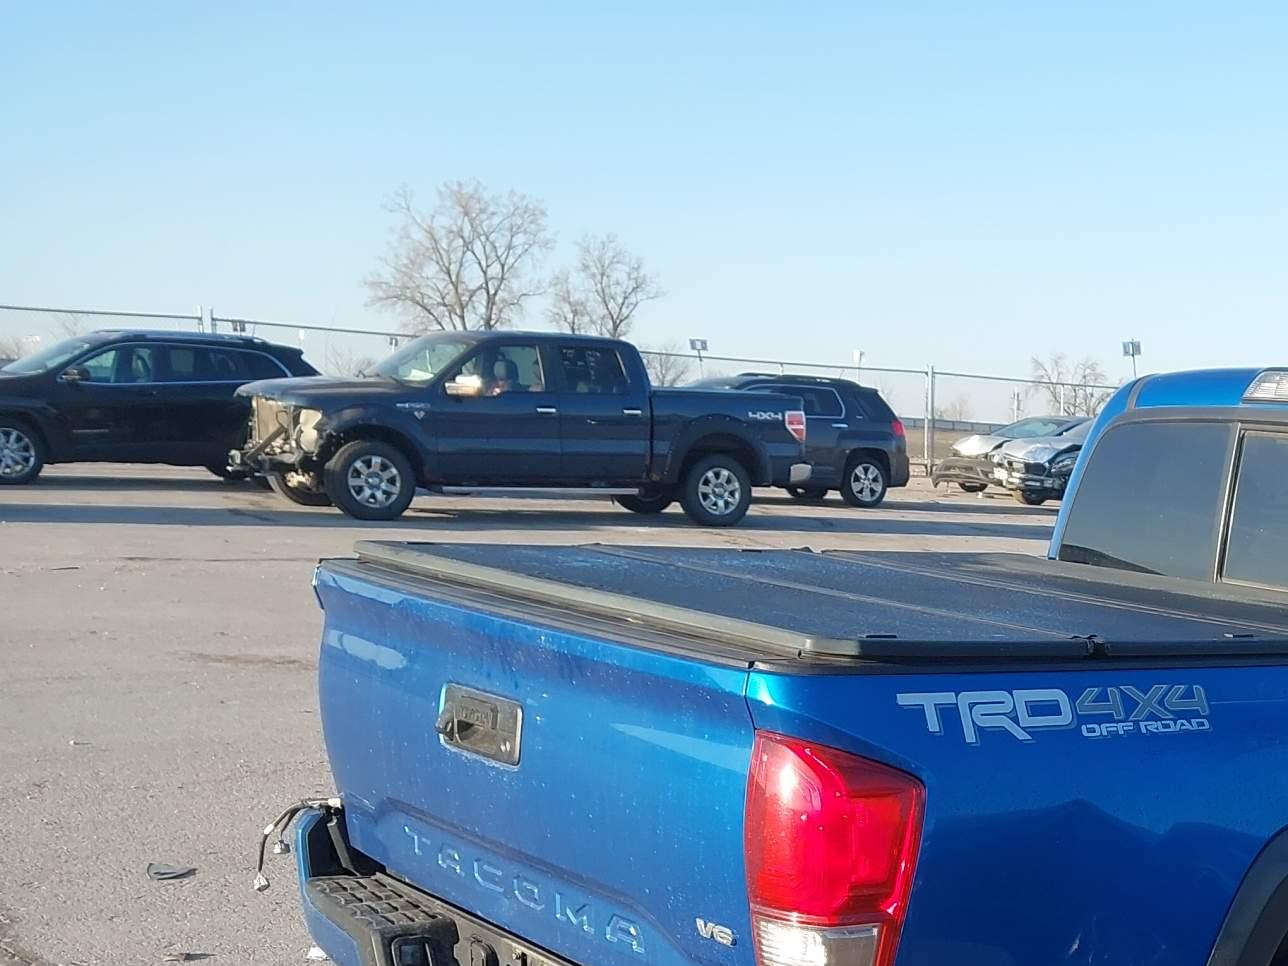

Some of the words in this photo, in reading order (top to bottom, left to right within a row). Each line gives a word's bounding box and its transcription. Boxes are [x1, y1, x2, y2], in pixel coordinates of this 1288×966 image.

[896, 688, 1075, 744] TRD
[1075, 684, 1211, 721] 4X4
[1081, 722, 1134, 738] OFF
[1140, 718, 1211, 735] ROAD
[403, 825, 647, 954] TACOMA
[695, 917, 738, 946] V6
